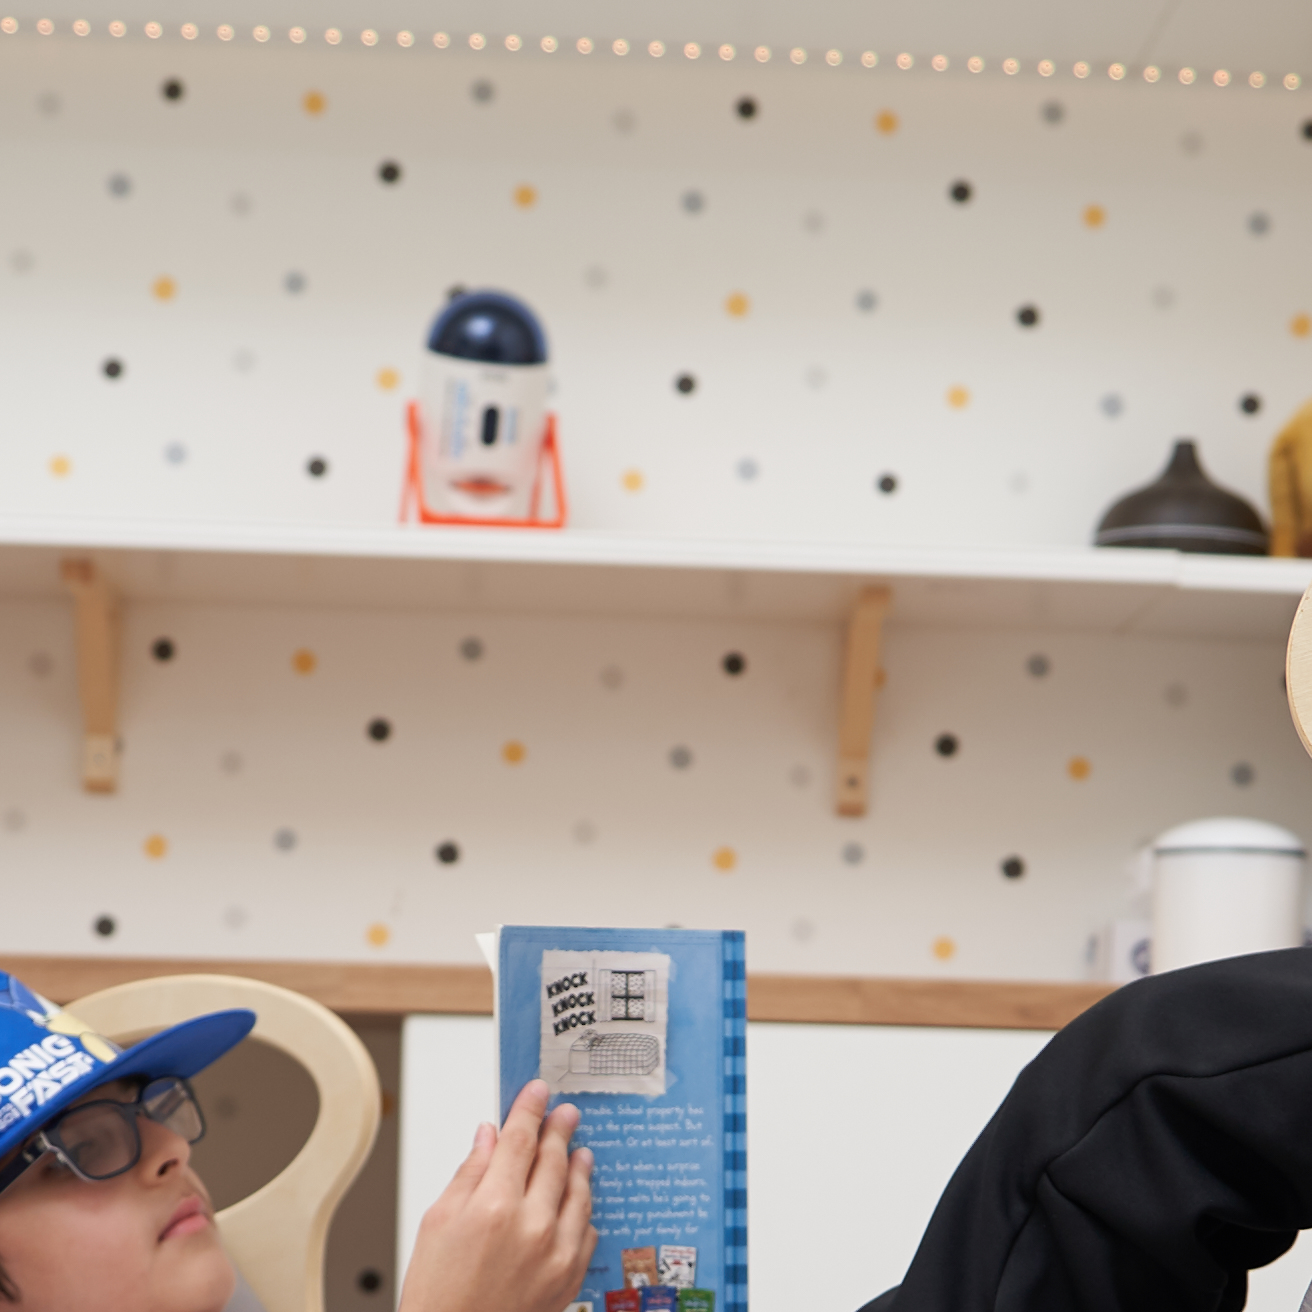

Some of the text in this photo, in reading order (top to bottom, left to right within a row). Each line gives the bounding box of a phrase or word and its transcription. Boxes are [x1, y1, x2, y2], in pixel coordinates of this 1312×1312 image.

[546, 971, 588, 999] KNOCK
[551, 991, 595, 1018] KNOCK
[552, 1010, 596, 1037] KNOCK
